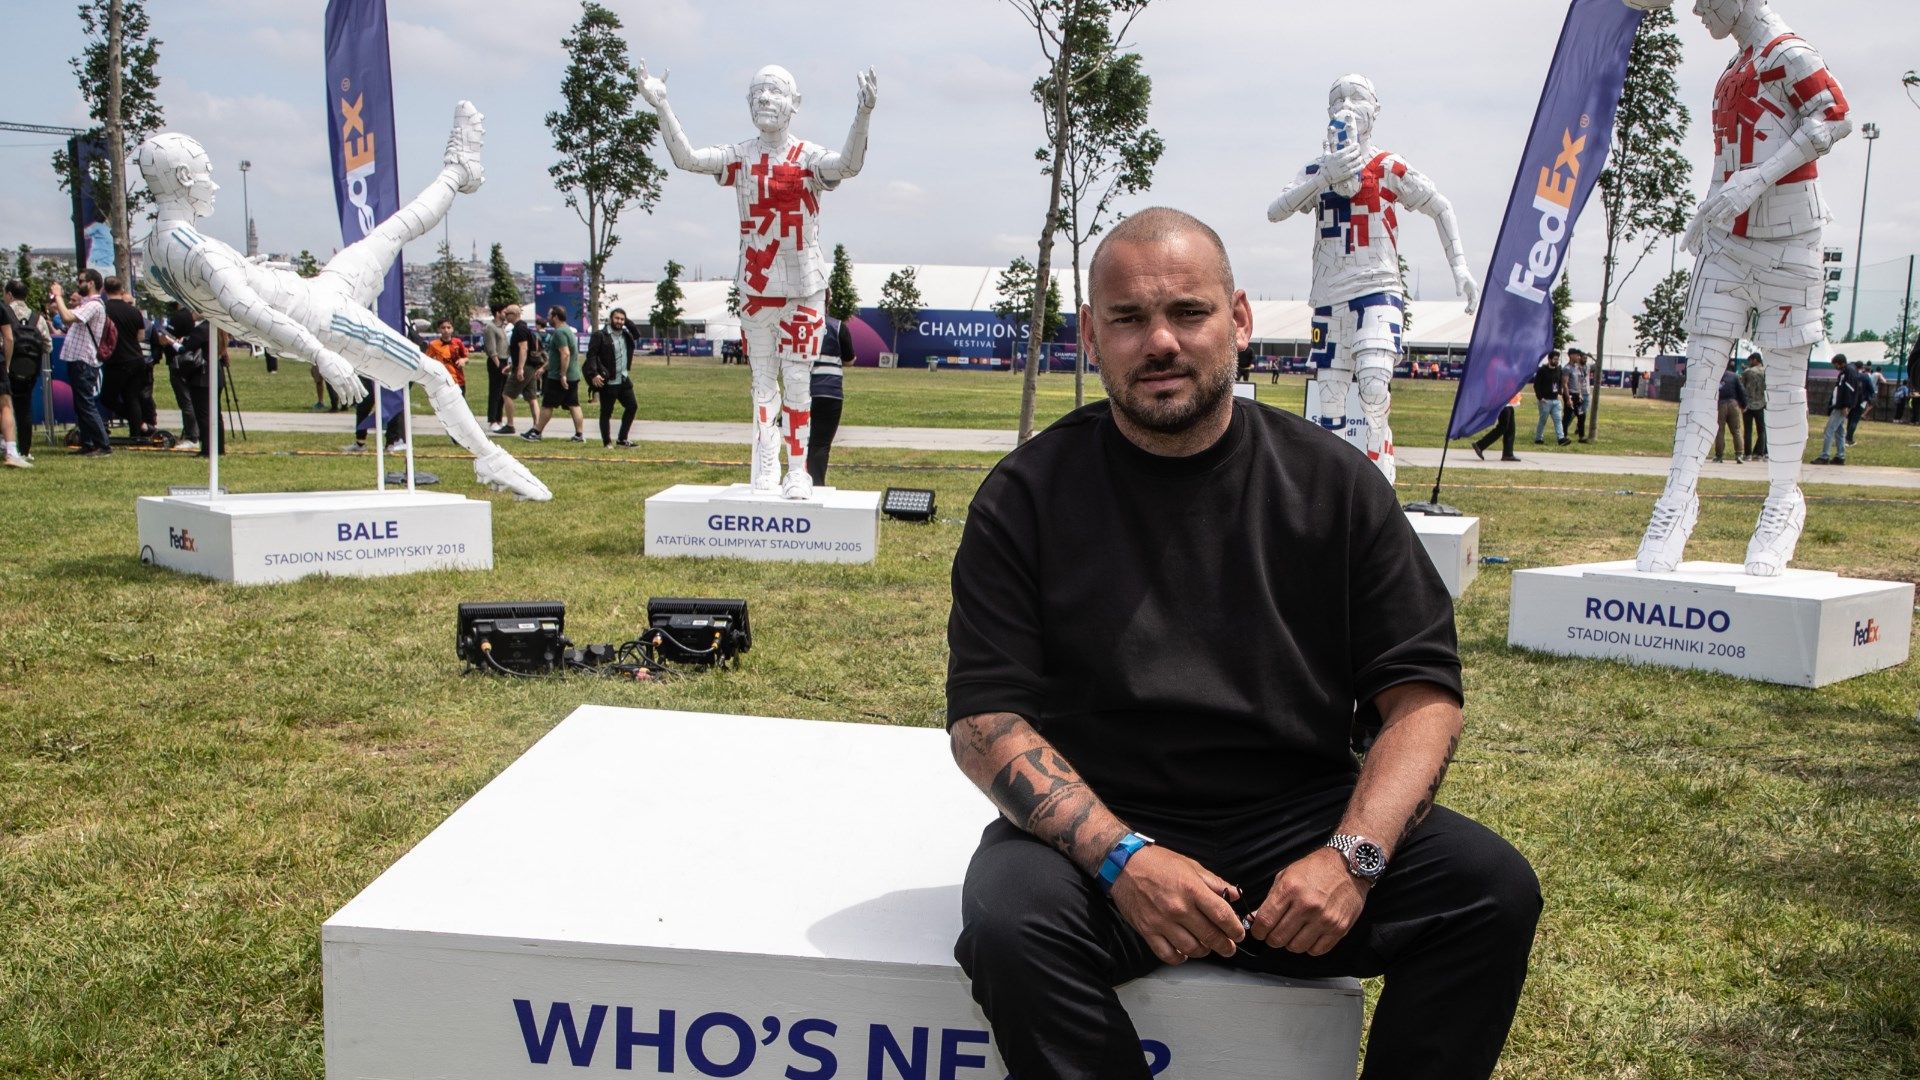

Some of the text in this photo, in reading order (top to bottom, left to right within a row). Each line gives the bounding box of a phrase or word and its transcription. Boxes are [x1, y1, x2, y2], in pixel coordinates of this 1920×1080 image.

[1504, 126, 1587, 305] FedEx
[1778, 305, 1792, 324] 7
[797, 325, 807, 340] 8
[918, 321, 1031, 339] CHAMPIONS
[953, 339, 997, 348] FESTIVAL
[337, 520, 399, 542] BALE
[707, 514, 811, 534] GERRARD
[169, 526, 196, 553] FedEx
[655, 534, 862, 552] ATATÜRK OLIMPIYAT STADYUMU 2005
[264, 543, 466, 566] STADION NSC OLIMPIYSKIY 2018
[1585, 597, 1730, 633] RONALDO
[1567, 626, 1746, 660] STADION LUZHNIKI 2008
[1853, 618, 1880, 647] FedEx
